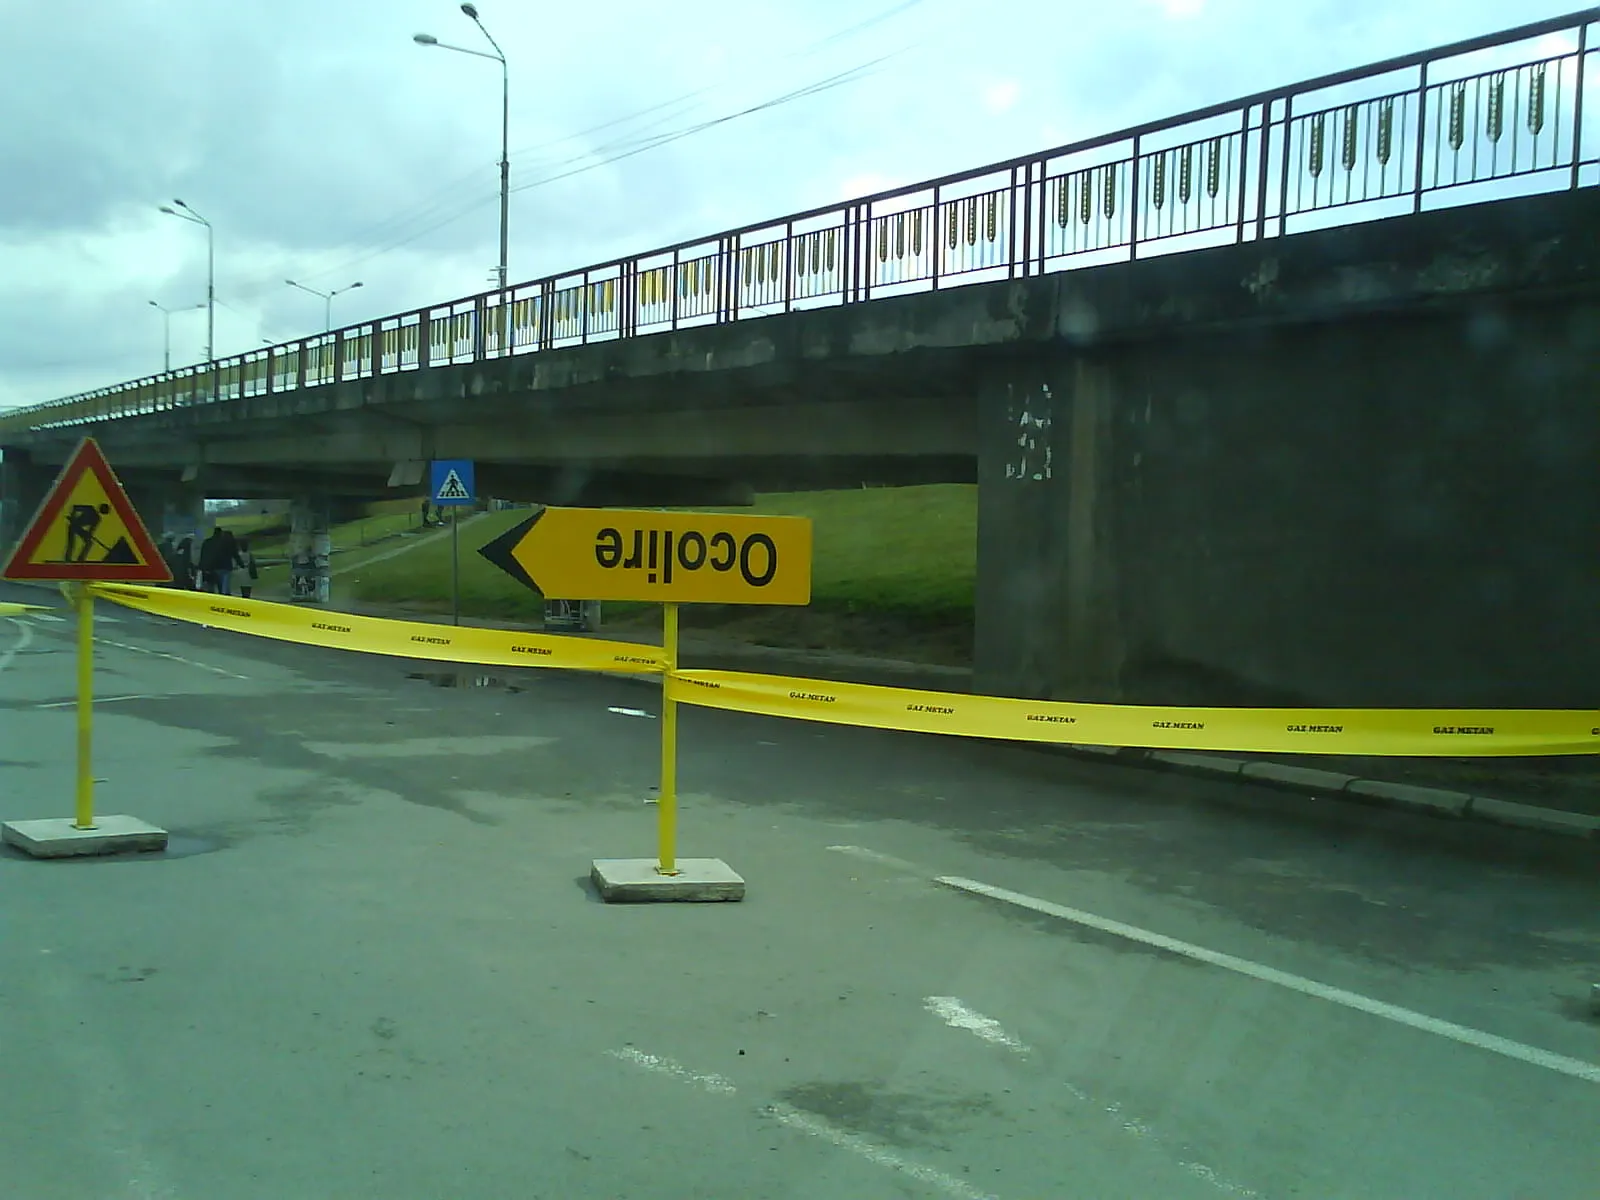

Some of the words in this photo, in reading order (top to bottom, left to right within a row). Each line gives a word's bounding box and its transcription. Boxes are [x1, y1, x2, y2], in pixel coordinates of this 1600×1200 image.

[595, 528, 777, 586] Ocolire
[806, 694, 836, 703] METAN
[925, 706, 954, 715] METAN
[1027, 714, 1044, 722] GAZ
[1045, 715, 1077, 724] METAN
[1172, 722, 1204, 730] METAN
[1287, 724, 1307, 732] GAZ
[1308, 725, 1343, 734] METAN
[1433, 726, 1455, 734] GAZ
[1456, 726, 1494, 735] METAN
